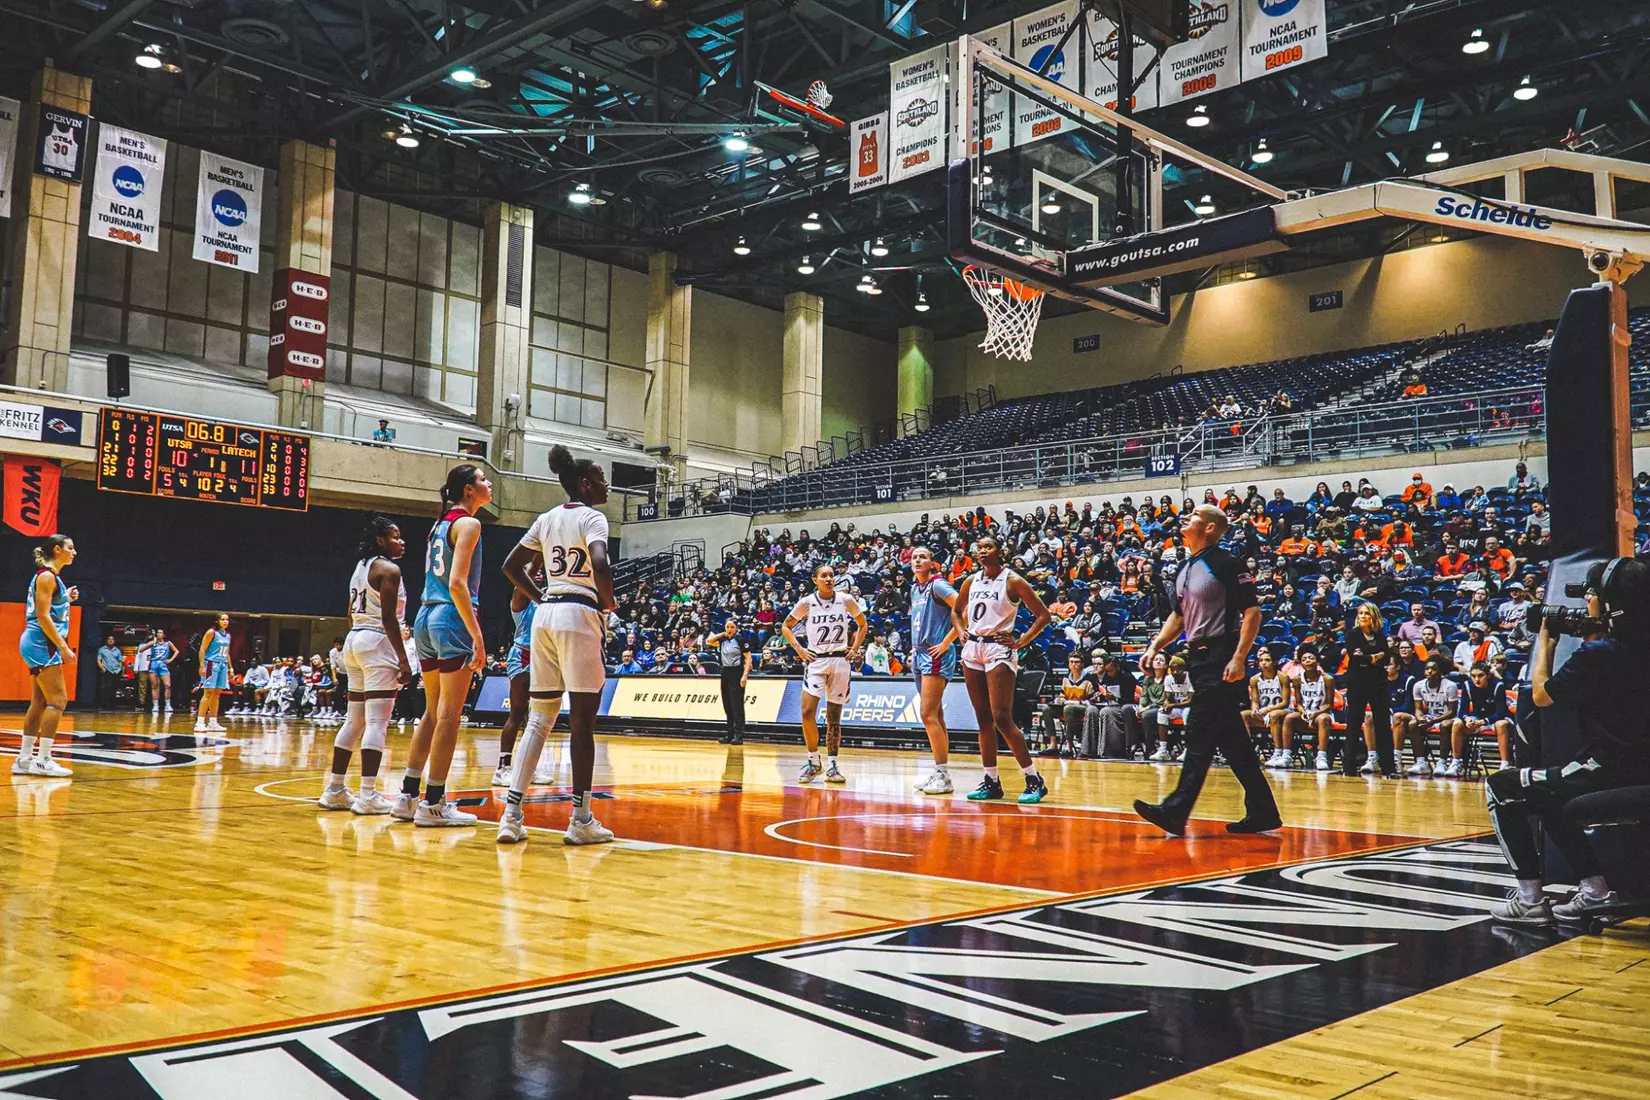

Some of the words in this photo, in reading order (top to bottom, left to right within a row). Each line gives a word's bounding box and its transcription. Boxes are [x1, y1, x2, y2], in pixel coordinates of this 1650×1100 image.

[1028, 13, 1066, 34] WOMEN'S
[1270, 21, 1296, 38] NCAA
[1249, 26, 1318, 56] TOURNAMENT
[1171, 46, 1228, 70] TOURNAMENT
[1266, 46, 1302, 70] 2009
[903, 60, 934, 77] WOMEN'S
[1174, 59, 1224, 80] CHAMPIONS
[896, 70, 940, 90] BASKETBALL
[1182, 74, 1216, 96] 2009
[46, 112, 82, 128] GERVIN
[858, 118, 880, 130] GIBBS
[1032, 117, 1061, 136] 2008
[53, 143, 68, 156] 30
[120, 137, 145, 149] MEN'S
[896, 136, 938, 156] CHAMPIONS
[105, 144, 157, 163] BASKETBALL
[864, 150, 873, 163] 33
[220, 166, 244, 179] MEN'S
[116, 179, 143, 191] NCAA
[208, 172, 254, 192] BASKETBALL
[853, 175, 883, 189] 2005-2009
[110, 203, 143, 220] NCAA
[215, 205, 246, 220] NCAA
[98, 213, 154, 233] TOURNAMENT
[218, 231, 237, 242] NCAA
[202, 235, 252, 254] TOURNAMENT
[1075, 237, 1199, 272] www.goutsa.com
[1317, 296, 1336, 307] 201
[1078, 339, 1095, 349] 200
[6, 409, 40, 423] FRITZ
[0, 419, 39, 431] KENNEL
[112, 420, 120, 430] 0
[147, 426, 154, 435] 2
[162, 424, 184, 432] UTSA
[188, 422, 224, 442] 06.8
[115, 433, 119, 441] 1
[129, 434, 136, 444] 0
[146, 437, 153, 446] 0
[104, 442, 118, 452] 21
[146, 448, 152, 457] 0
[168, 438, 192, 449] UTSA
[222, 446, 256, 458] LATECH
[271, 443, 277, 452] 2
[286, 445, 292, 454] 0
[103, 454, 118, 465] 22
[127, 457, 134, 467] 0
[145, 459, 152, 469] 0
[172, 450, 187, 467] 10
[210, 457, 214, 468] 1
[271, 454, 276, 462] 4
[285, 456, 291, 464] 0
[301, 457, 306, 466] 3
[1151, 460, 1174, 471] 102
[103, 465, 117, 476] 32
[126, 468, 134, 478] 0
[144, 471, 151, 480] 2
[266, 464, 276, 473] 10
[285, 466, 291, 475] 0
[300, 468, 305, 477] 2
[164, 474, 172, 486] 5
[180, 479, 187, 487] 4
[198, 478, 211, 491] 10
[215, 480, 224, 492] 2
[263, 474, 276, 484] 23
[284, 477, 290, 485] 0
[299, 478, 305, 487] 0
[21, 465, 42, 526] WKU
[263, 484, 275, 494] 33
[284, 487, 290, 496] 0
[299, 489, 304, 498] 0
[877, 489, 891, 498] 101
[641, 508, 654, 516] 100
[549, 546, 591, 577] 32
[812, 614, 844, 624] UTSA
[973, 602, 986, 622] 0
[816, 625, 844, 646] 22
[634, 693, 649, 702] WE
[652, 694, 681, 702] BUILD
[685, 695, 719, 704] TOUGH
[856, 695, 905, 708] RHINO
[818, 708, 894, 722] ROFERS
